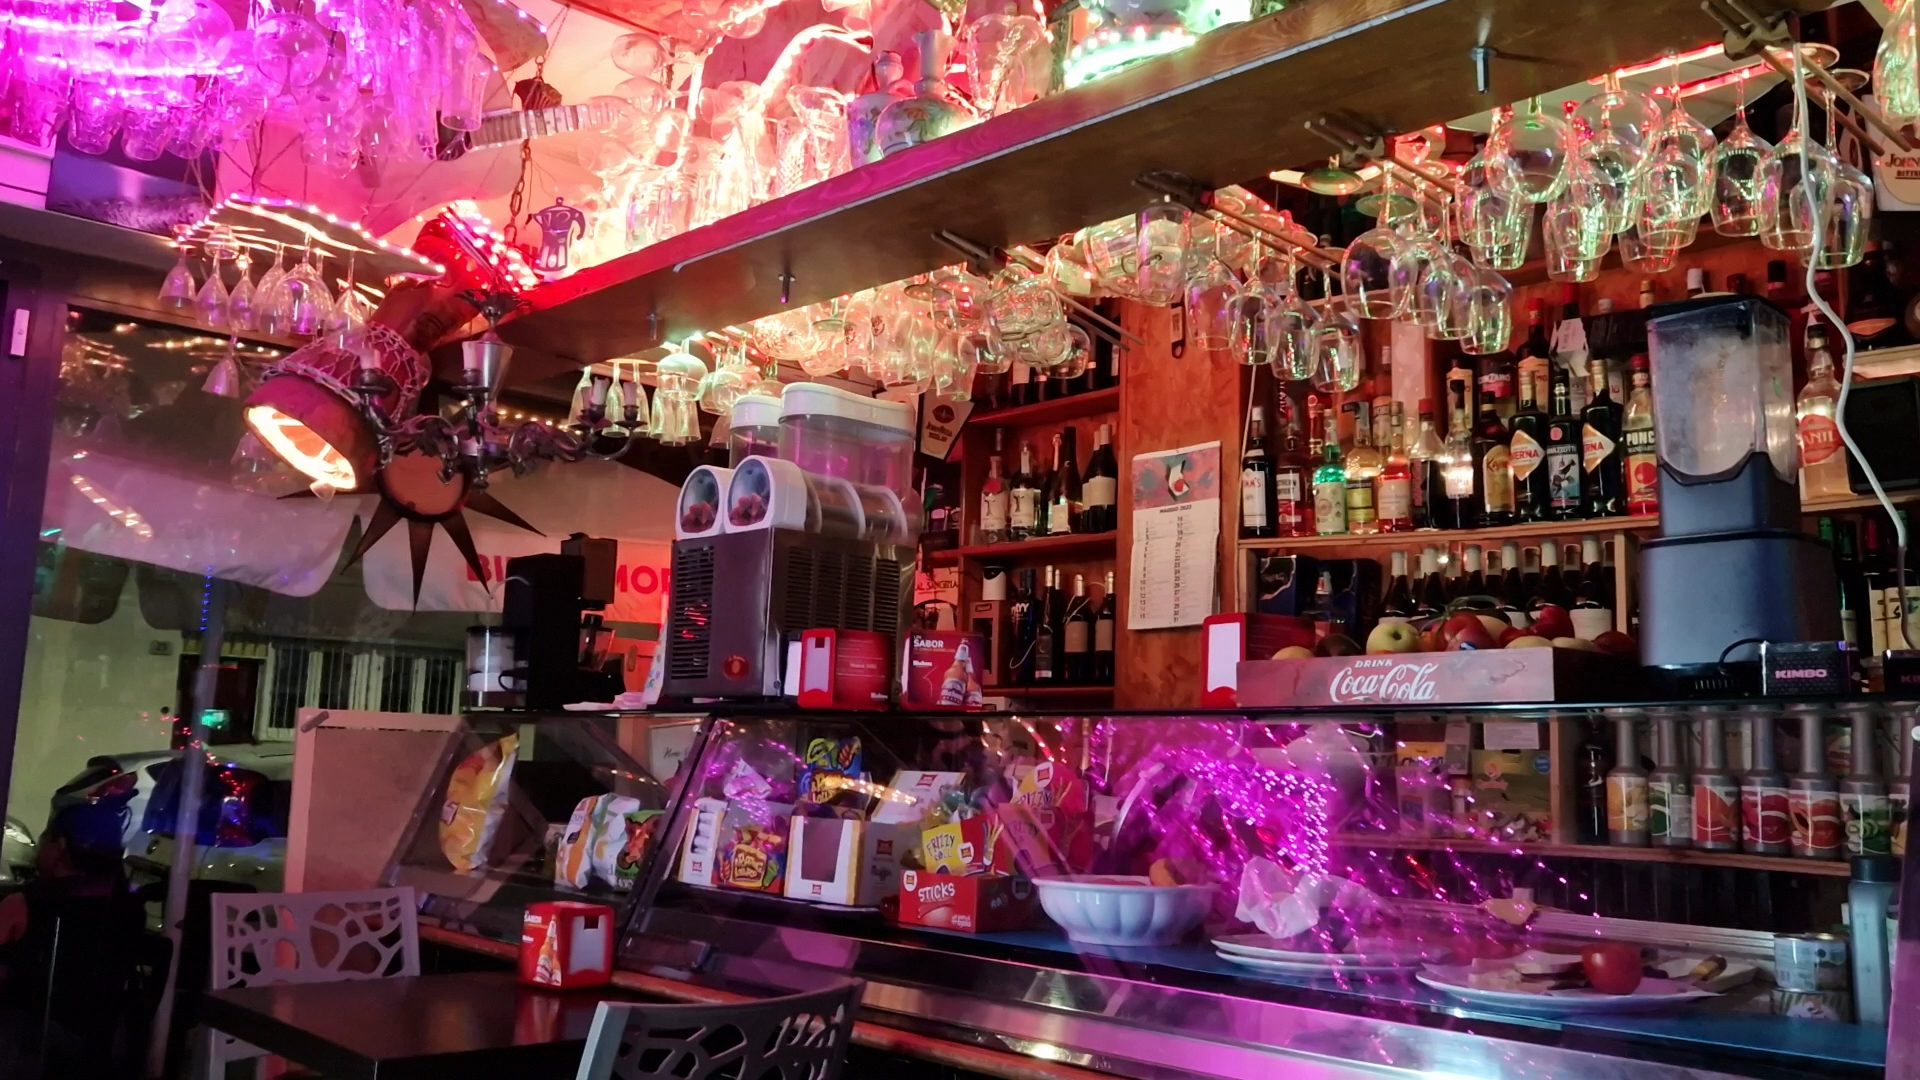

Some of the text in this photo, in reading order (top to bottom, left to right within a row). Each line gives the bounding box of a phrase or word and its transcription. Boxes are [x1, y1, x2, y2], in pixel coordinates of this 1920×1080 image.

[914, 640, 944, 648] SABOR
[1355, 659, 1393, 668] DRINK
[1775, 669, 1827, 679] KIMBO
[1330, 663, 1439, 703] Coca-Cola
[926, 834, 955, 857] FRIZZY
[918, 882, 955, 902] STICKS
